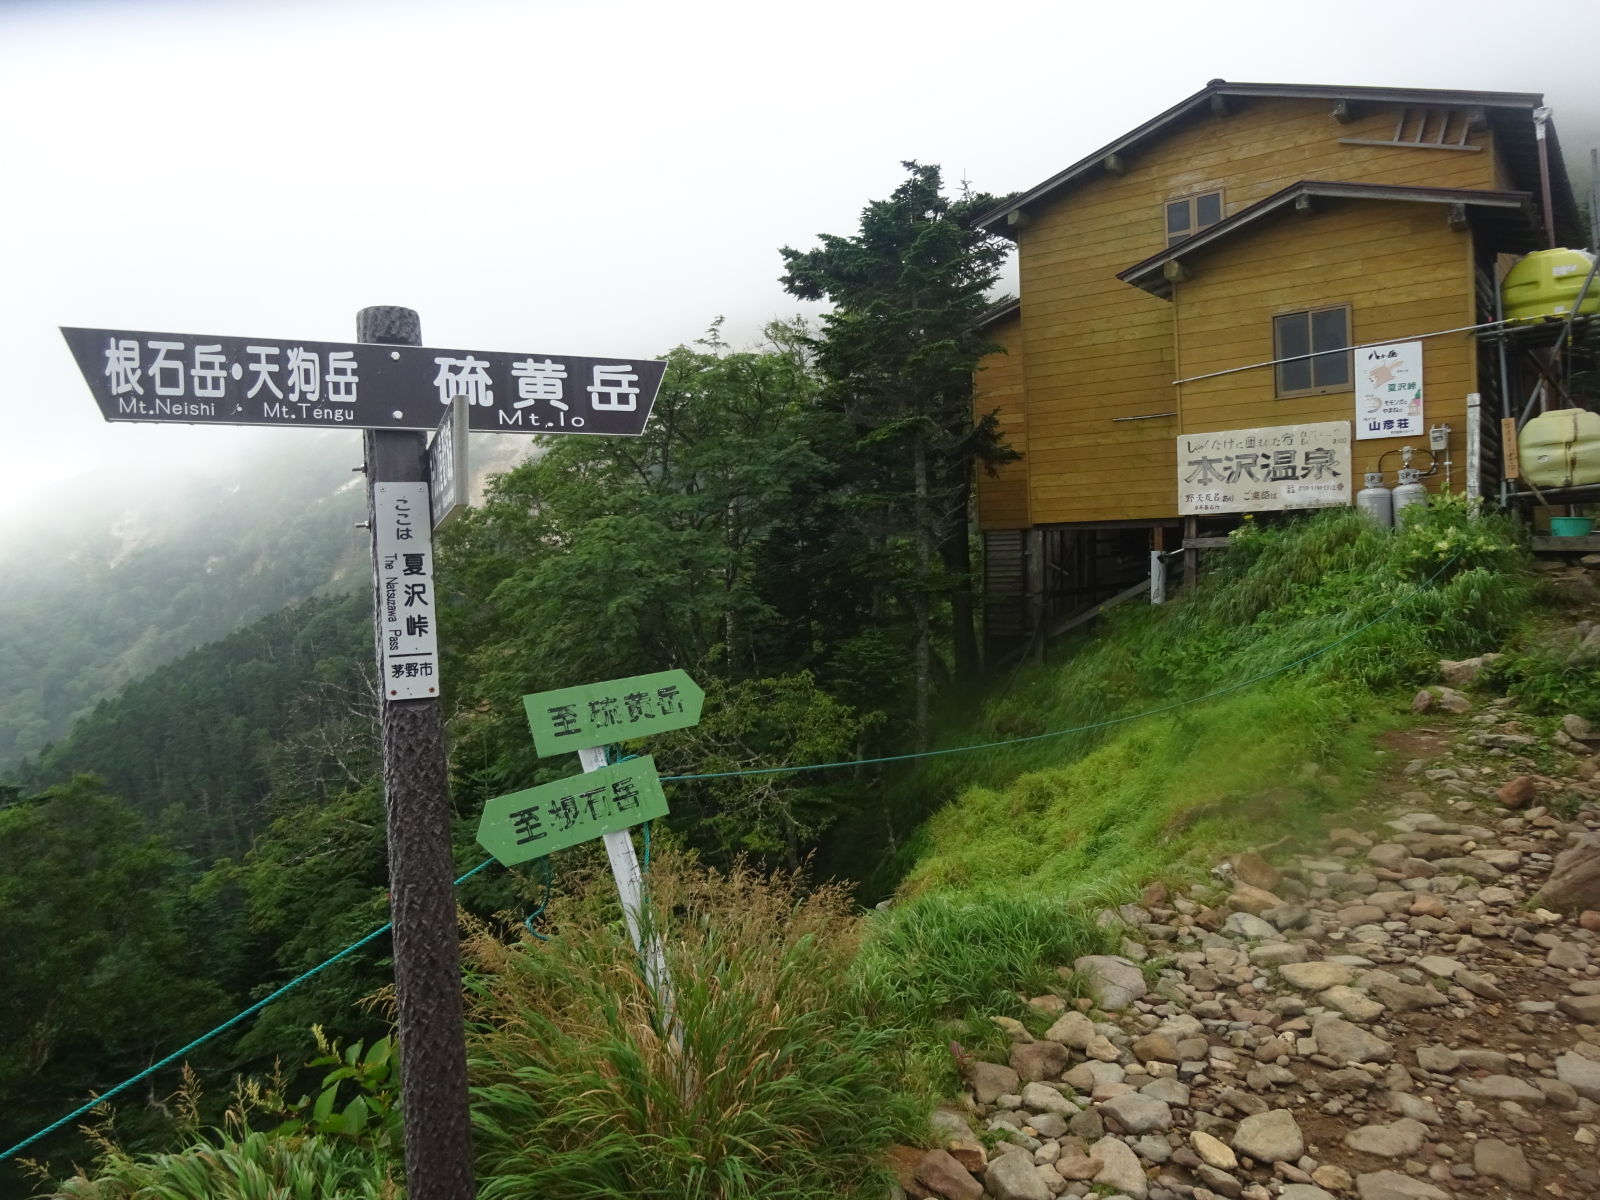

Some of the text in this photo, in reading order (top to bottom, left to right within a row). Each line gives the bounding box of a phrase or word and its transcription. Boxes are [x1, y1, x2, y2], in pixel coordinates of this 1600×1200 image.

[433, 355, 640, 413] 硫黄岳
[1388, 381, 1416, 392] 夏沢峠
[118, 396, 216, 417] Mt.Neishi
[263, 399, 355, 421] Mt.Tengu
[1369, 418, 1410, 431] 山彦荘
[1184, 447, 1344, 487] 本沢温泉
[395, 498, 413, 540] ここは
[383, 553, 402, 651] The Natsuzawa Pass
[402, 553, 429, 637] 夏沢峠
[391, 662, 433, 679] 茅野市
